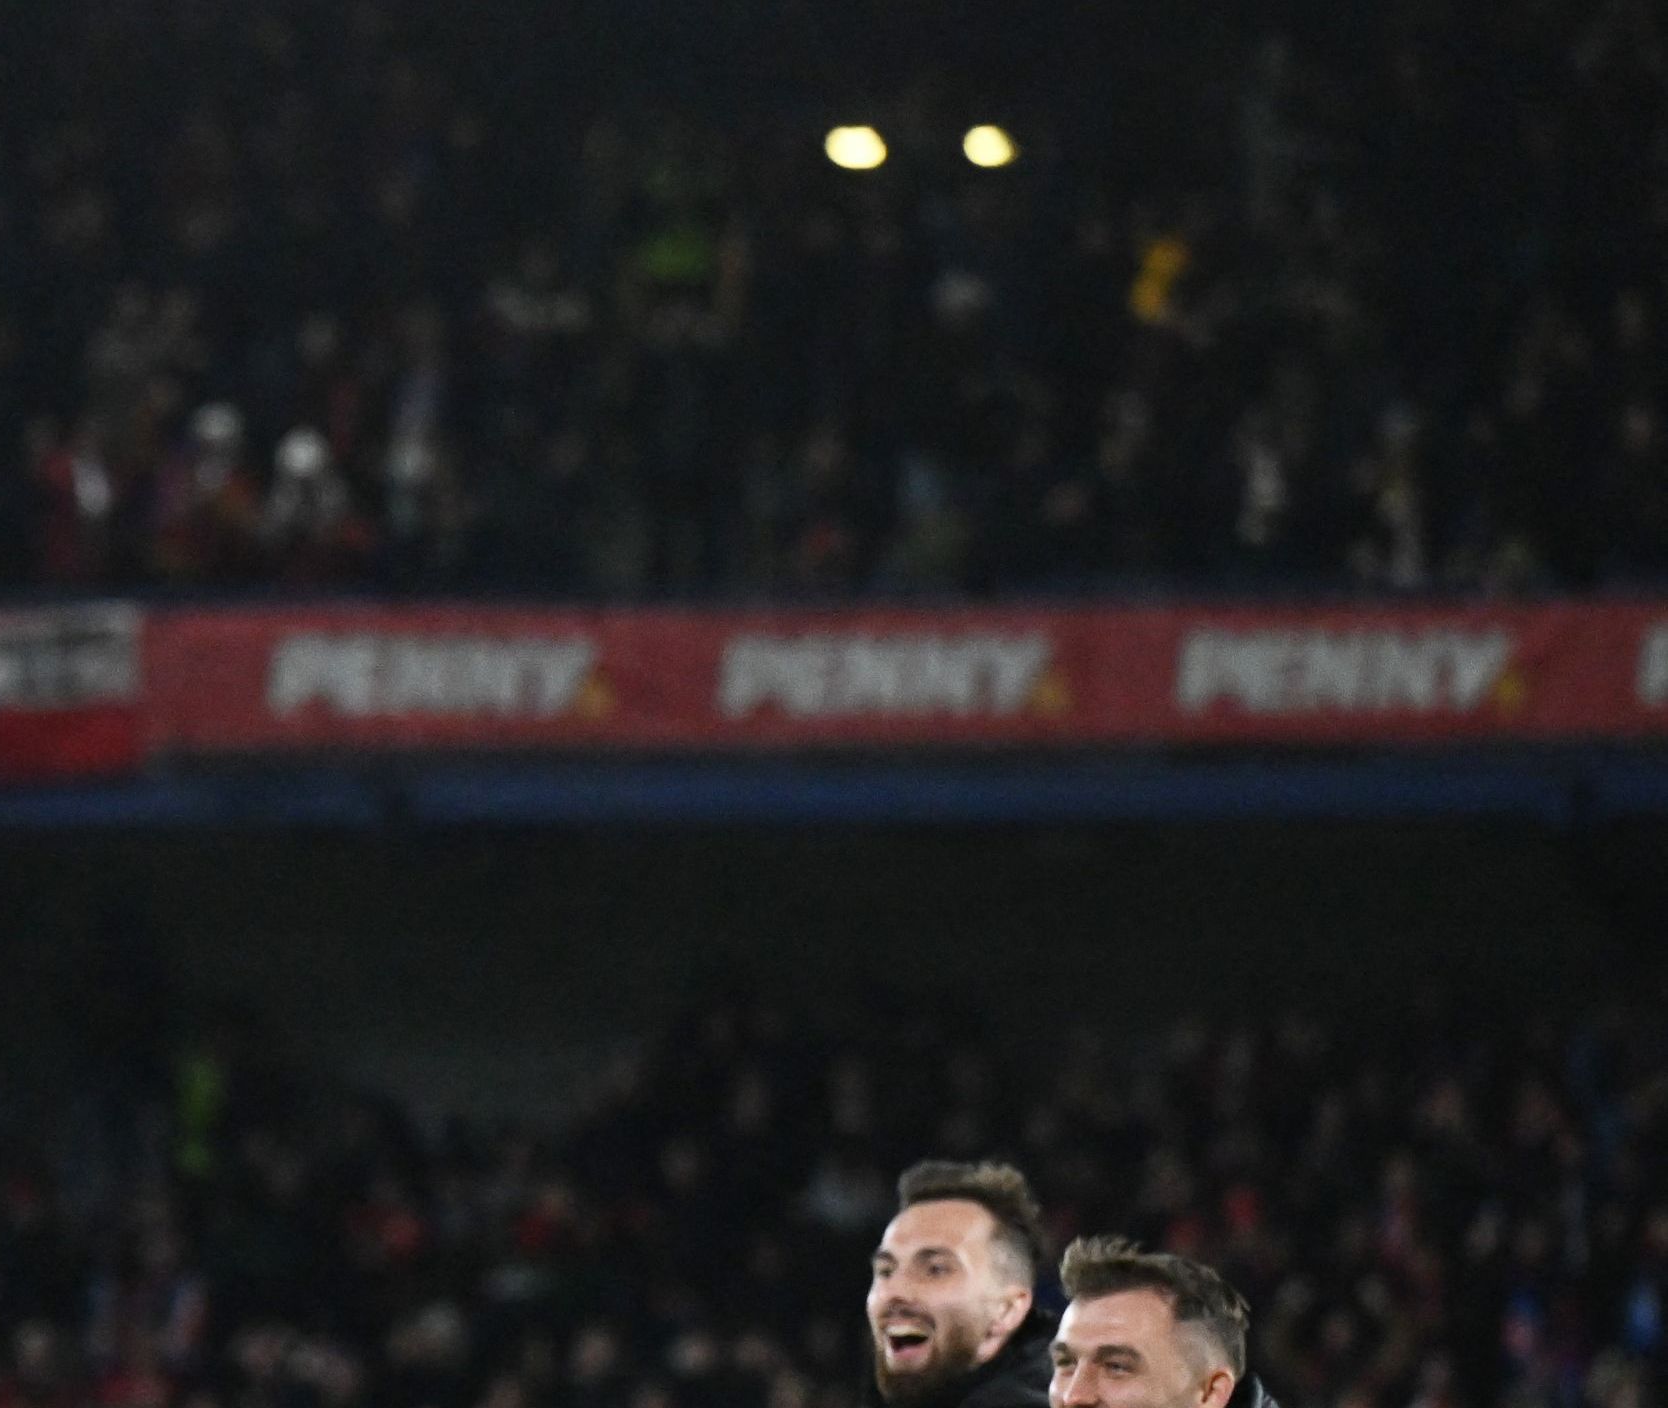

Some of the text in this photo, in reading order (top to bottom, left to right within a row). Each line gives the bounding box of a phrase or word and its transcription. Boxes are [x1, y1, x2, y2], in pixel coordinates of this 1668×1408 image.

[270, 632, 599, 718] PENNY
[719, 628, 1054, 716] PENNY
[1178, 625, 1517, 714] PENNY
